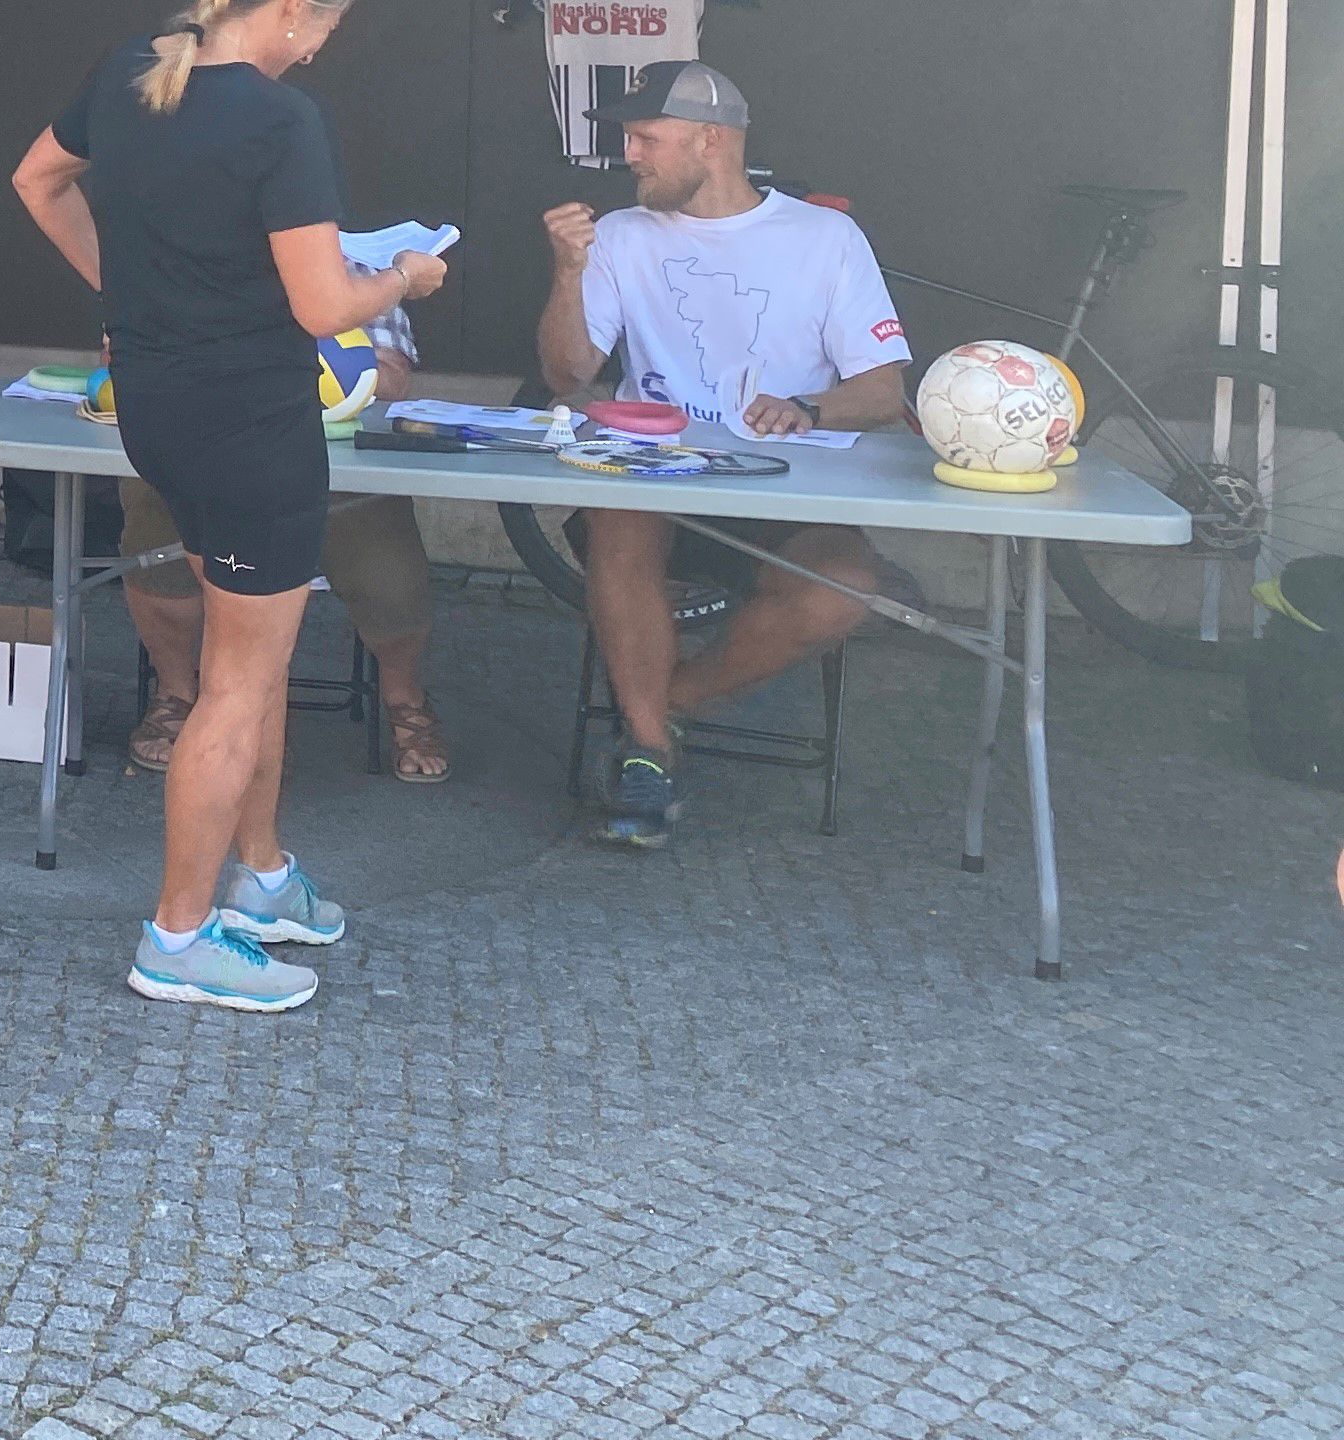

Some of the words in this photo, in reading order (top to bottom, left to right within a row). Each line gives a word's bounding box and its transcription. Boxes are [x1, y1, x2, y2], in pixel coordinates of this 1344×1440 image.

[553, 2, 606, 17] Maskin
[610, 2, 668, 18] Service
[553, 16, 668, 36] NORD
